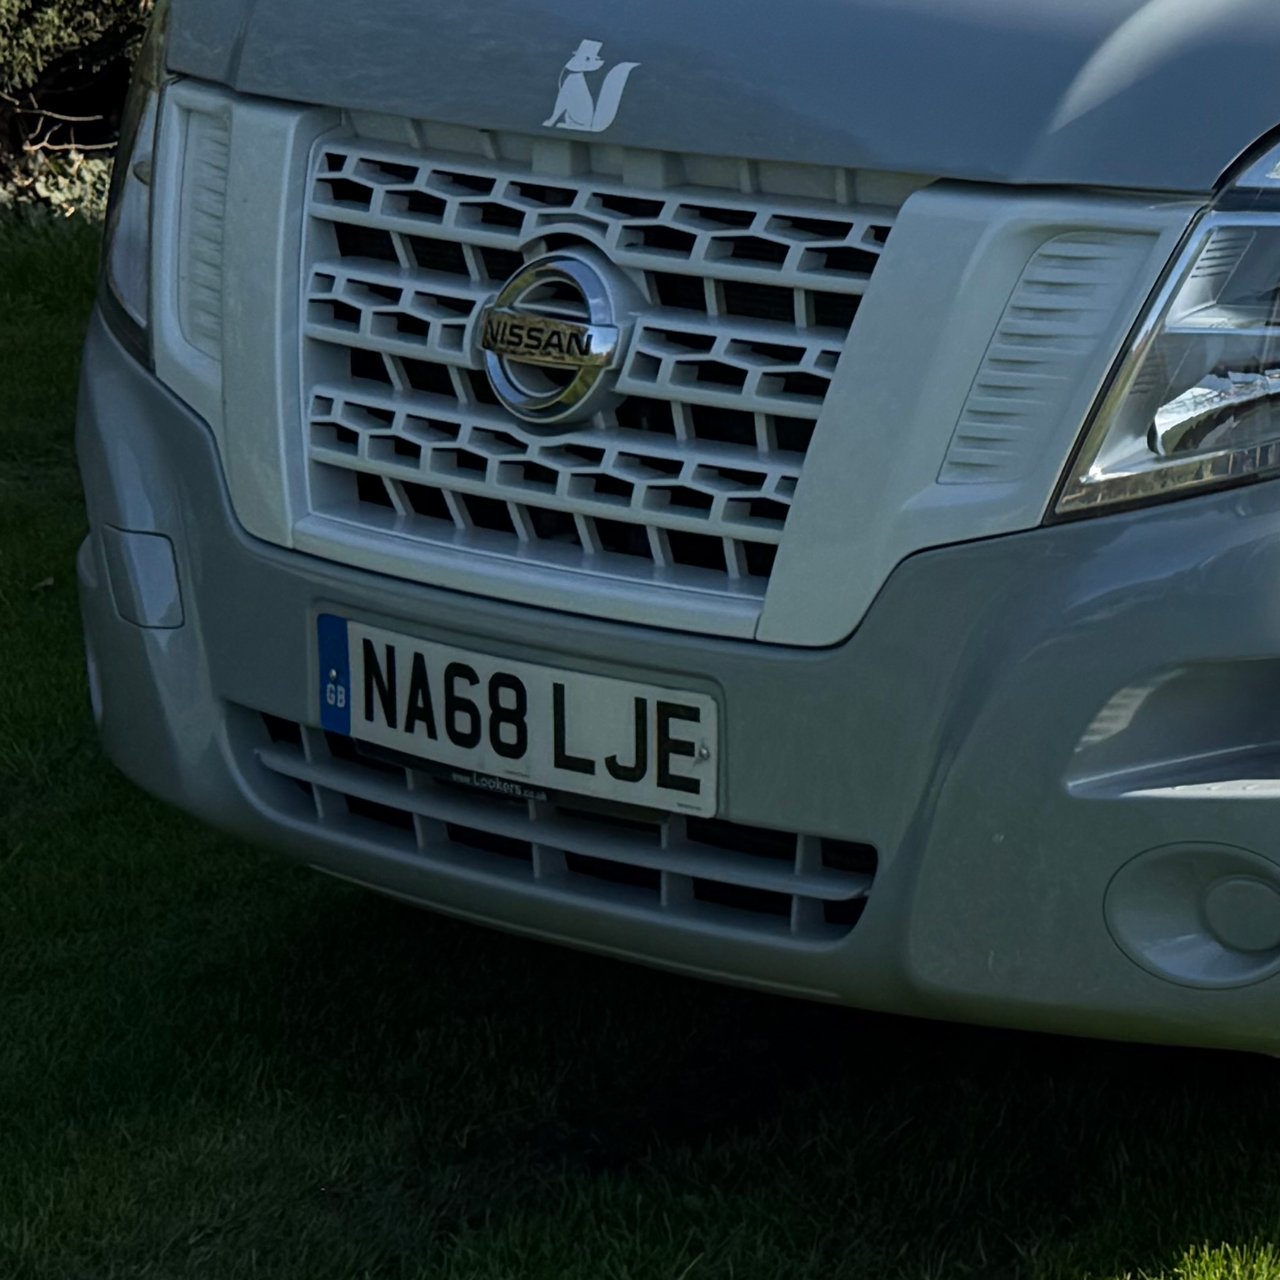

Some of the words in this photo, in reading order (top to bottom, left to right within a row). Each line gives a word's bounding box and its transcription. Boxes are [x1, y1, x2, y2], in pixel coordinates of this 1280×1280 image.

[484, 319, 593, 356] NISSAN
[326, 683, 346, 709] GB
[362, 637, 529, 761] NA68
[552, 681, 701, 796] LJE
